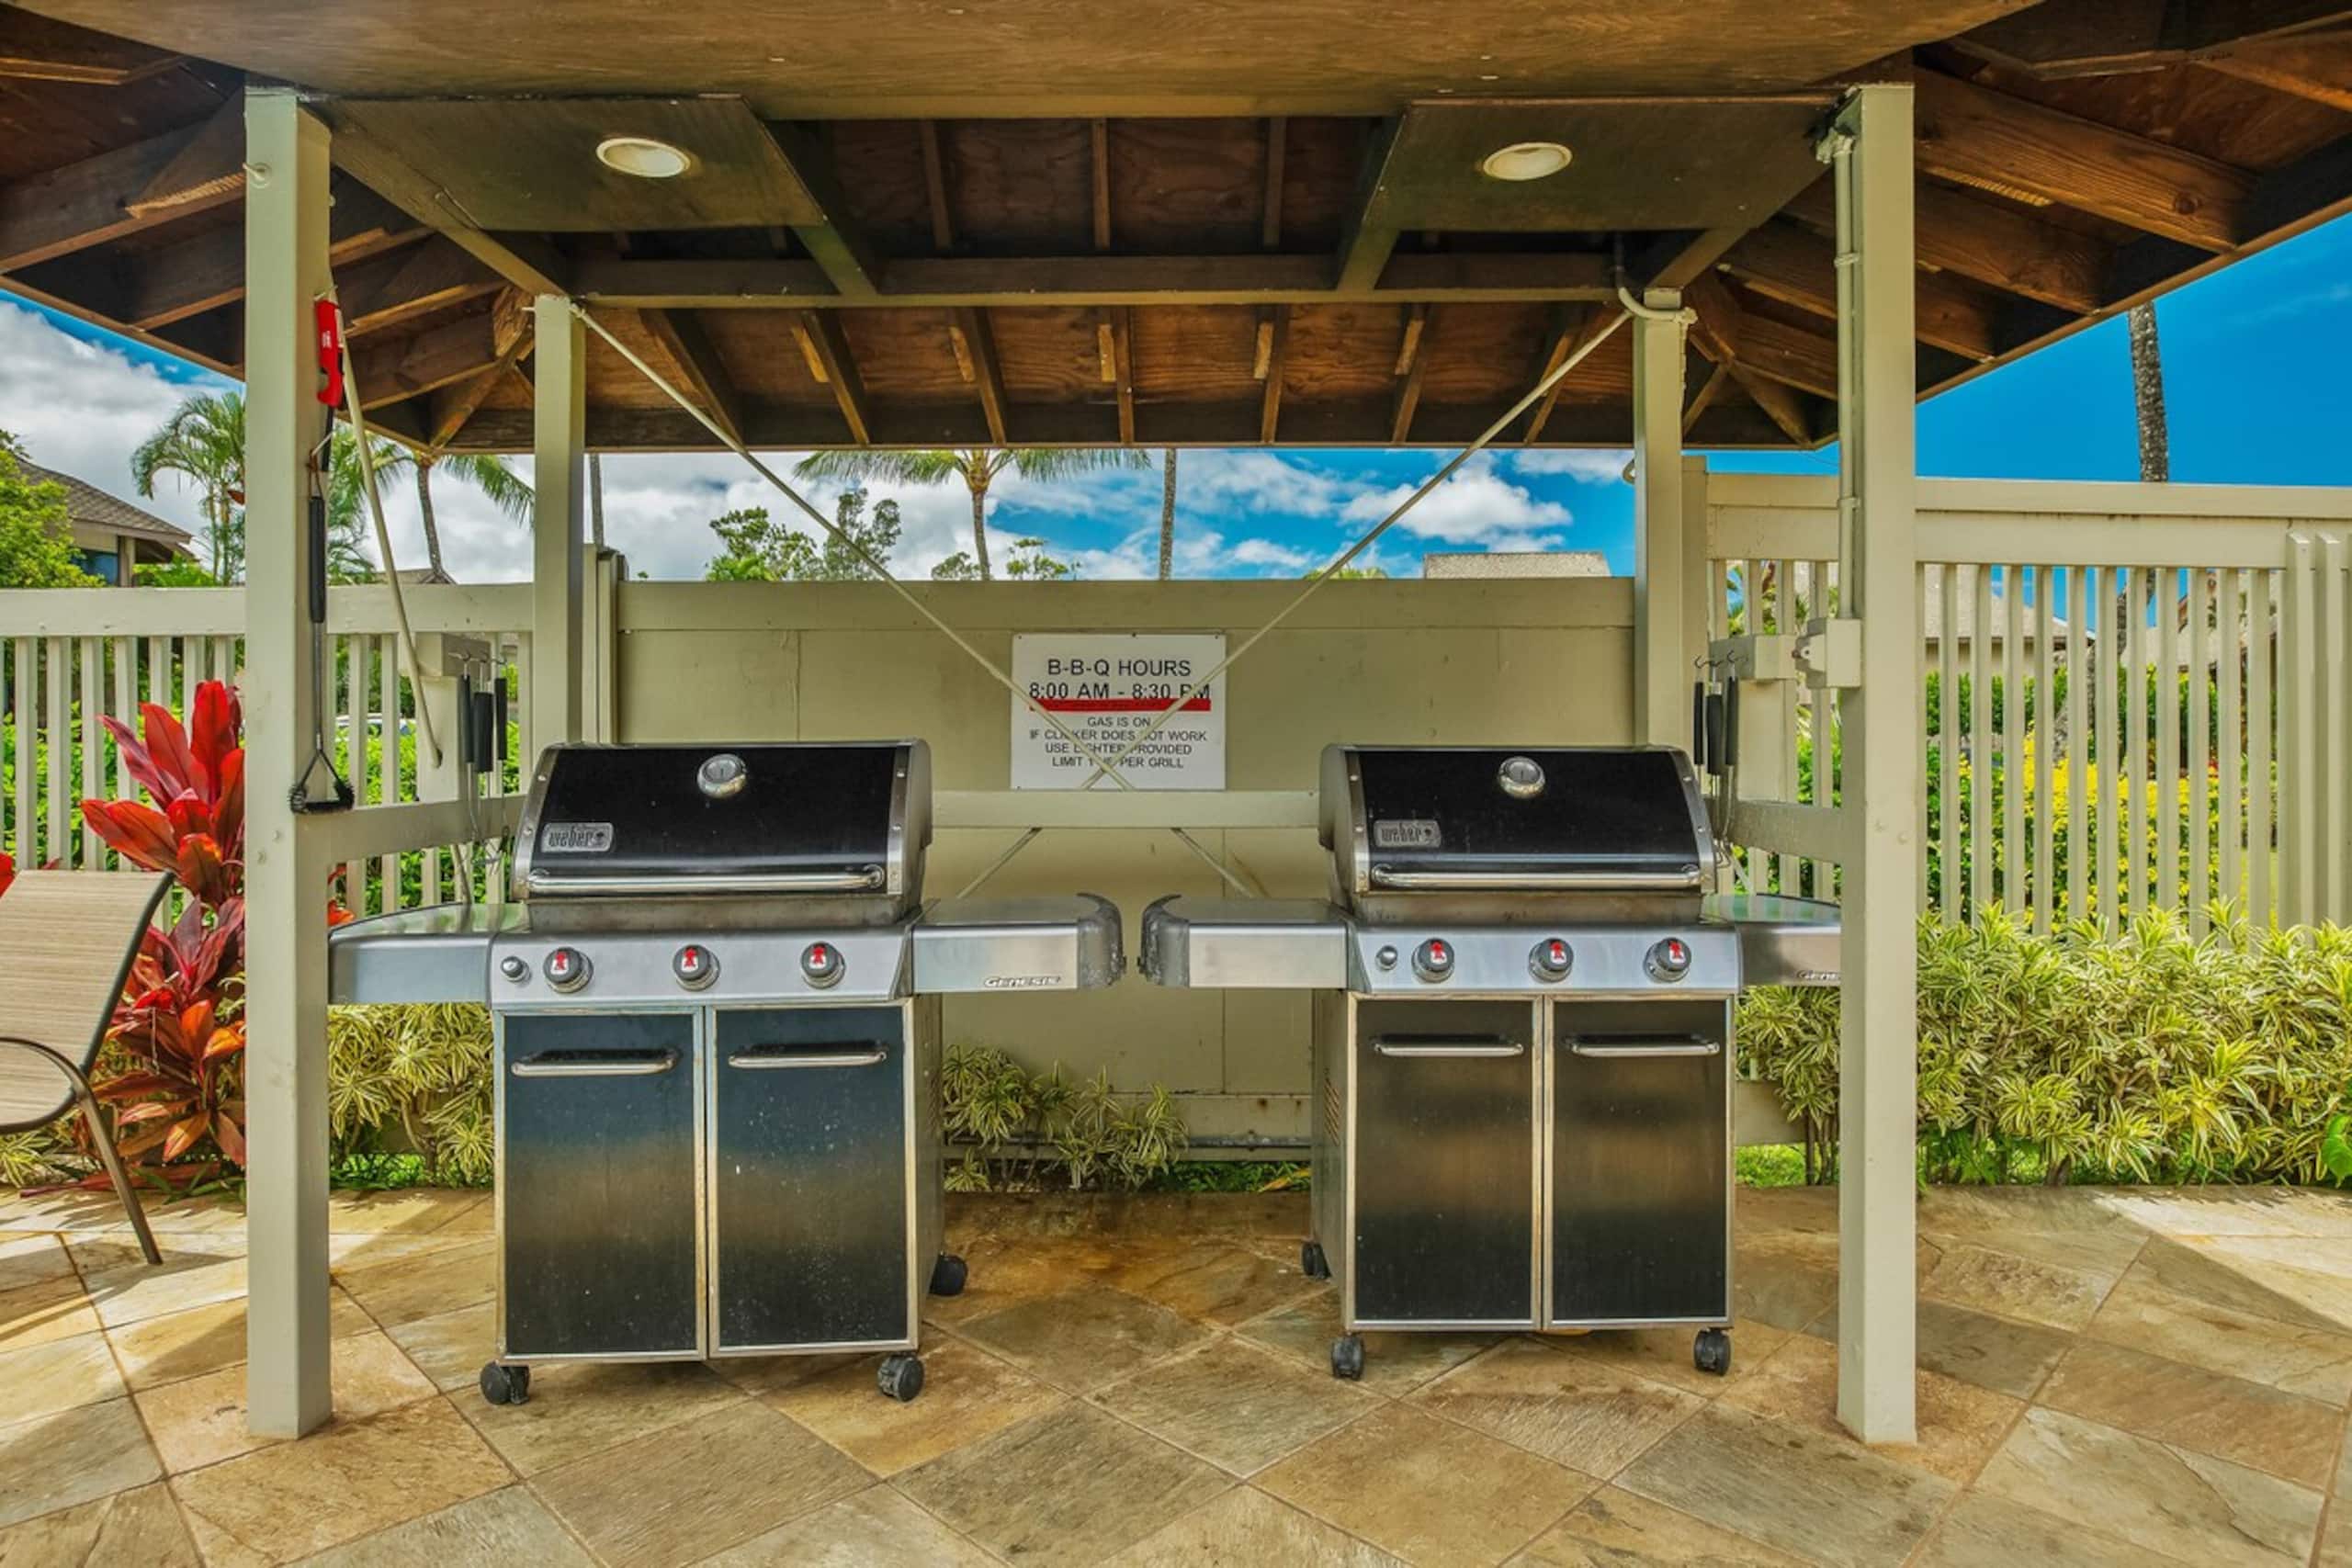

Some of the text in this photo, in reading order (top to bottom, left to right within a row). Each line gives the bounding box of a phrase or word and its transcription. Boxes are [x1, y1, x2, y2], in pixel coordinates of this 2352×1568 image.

[1047, 659, 1192, 676] B-B-Q HOURS
[1029, 682, 1069, 700] 8:00
[1077, 683, 1110, 700] AM
[1132, 683, 1170, 701] 8:30
[1180, 683, 1210, 700] PM
[1087, 716, 1150, 728] GAS IS ON
[1030, 729, 1039, 739] IF
[1102, 729, 1136, 740] DOES
[1139, 730, 1164, 741] OT
[1168, 731, 1206, 741] WORK
[1046, 742, 1193, 755] USE LGHTER ROVIDED
[1052, 757, 1082, 767] LIMIT
[1120, 756, 1144, 767] PER
[1148, 757, 1183, 768] GRILL
[548, 827, 593, 847] weber
[1381, 823, 1422, 842] weber
